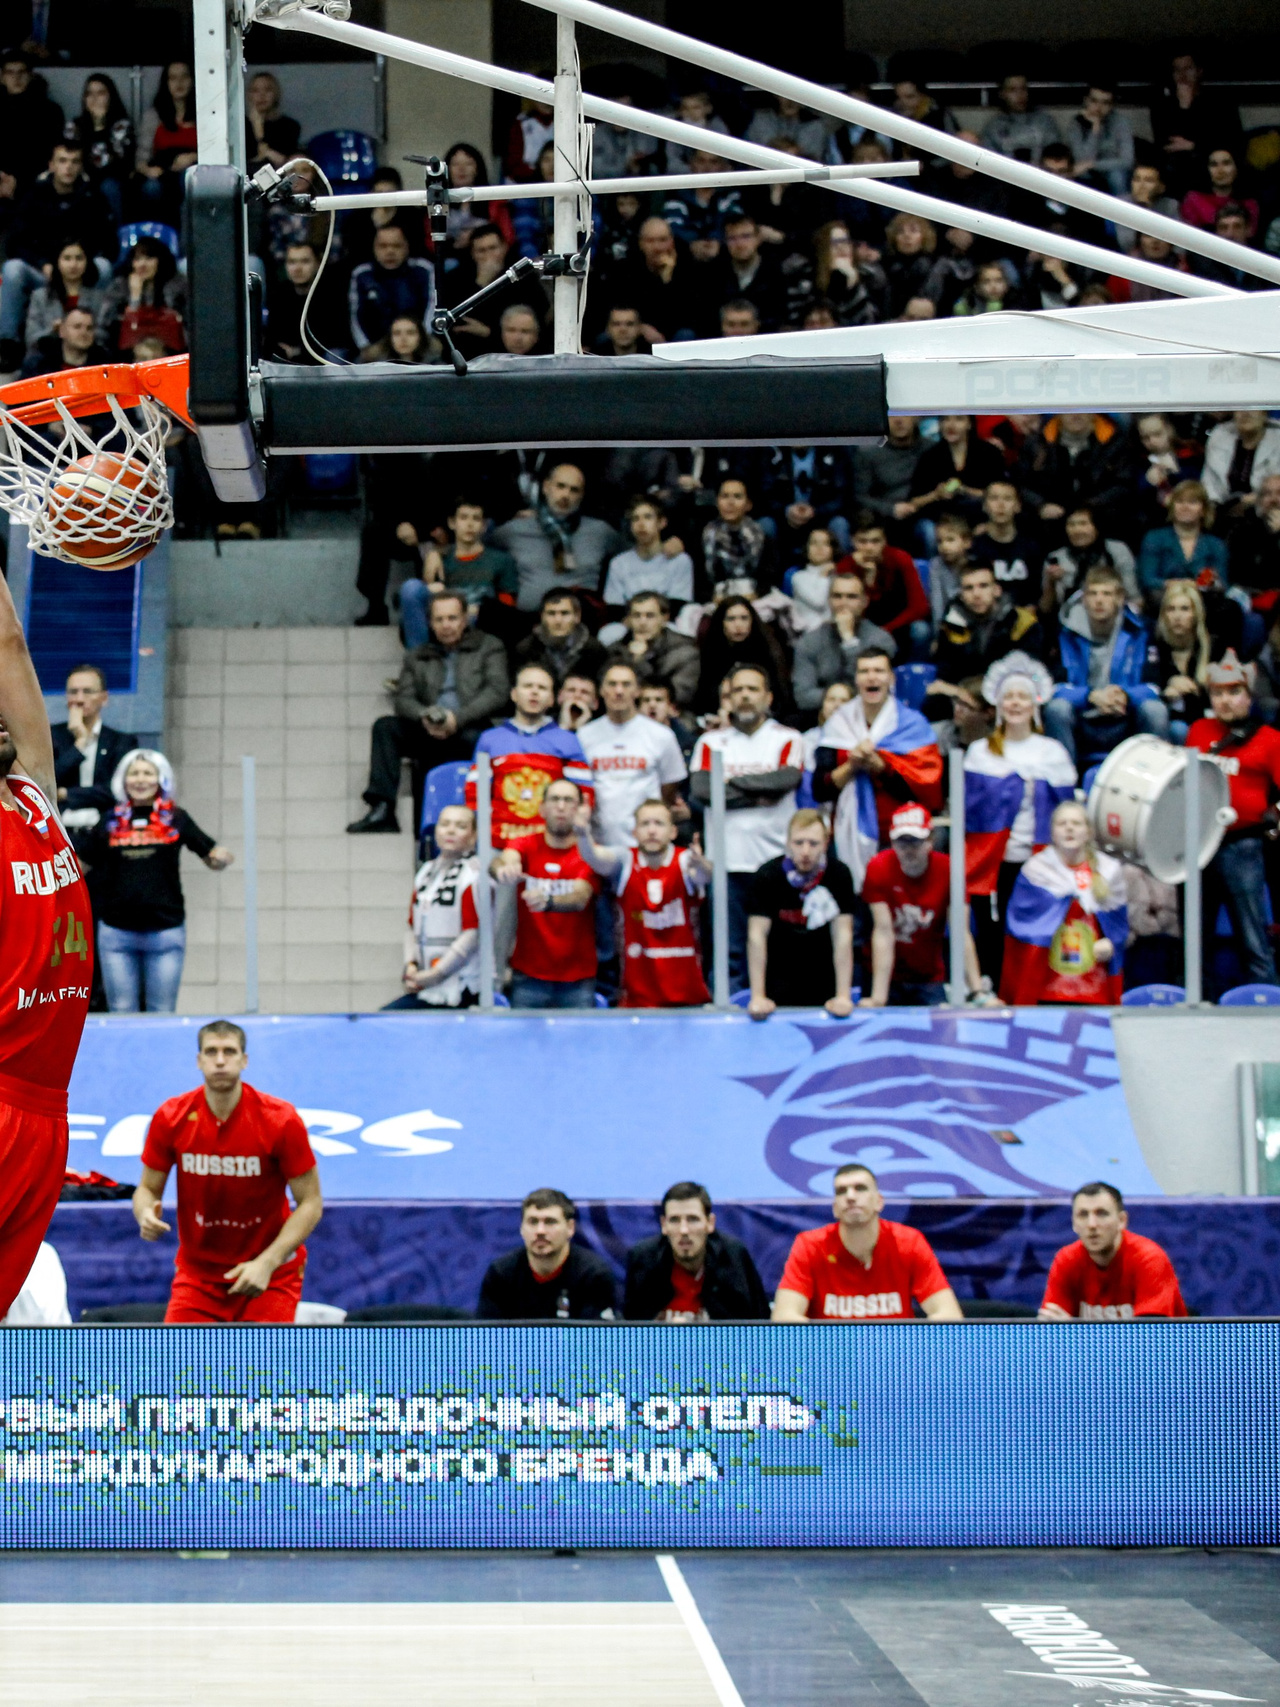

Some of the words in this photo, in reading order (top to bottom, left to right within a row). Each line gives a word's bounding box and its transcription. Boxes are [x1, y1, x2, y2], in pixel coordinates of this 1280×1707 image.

[182, 1153, 261, 1177] RUSSIA
[824, 1291, 902, 1317] RUSSIA
[643, 1395, 814, 1431] ОТЕЛЬ
[4, 1448, 498, 1488] МЕЖДУНАРОДНОГО
[515, 1447, 719, 1487] БРЕНДА
[981, 1602, 1151, 1677] AEROFLOT
